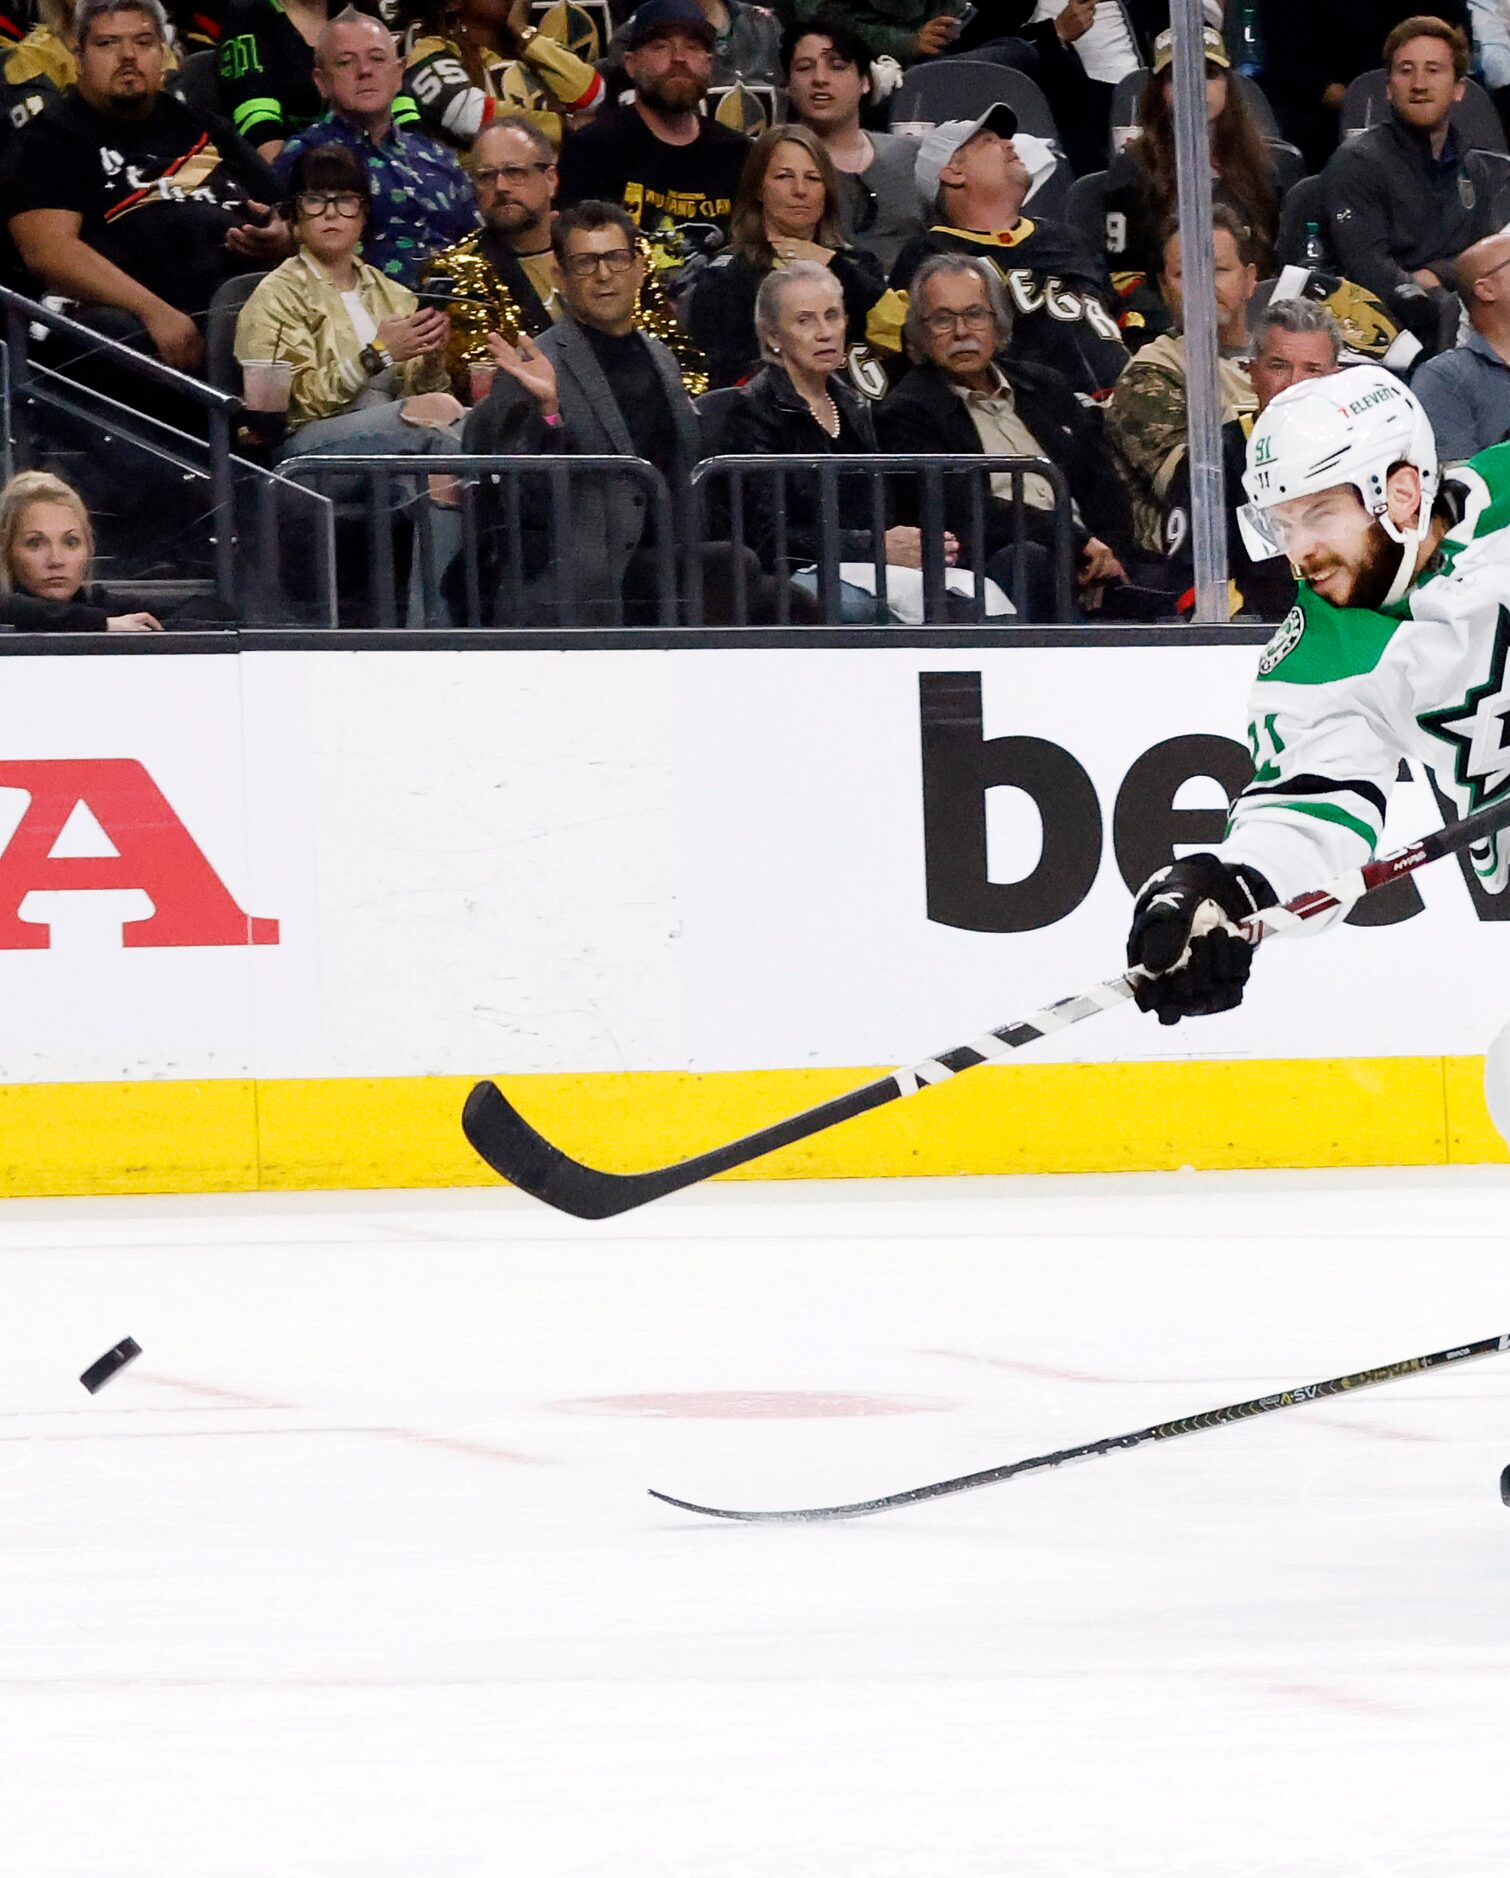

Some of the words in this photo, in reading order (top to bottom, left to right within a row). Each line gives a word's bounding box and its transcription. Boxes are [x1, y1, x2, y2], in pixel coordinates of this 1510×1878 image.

[412, 58, 470, 105] 55
[1255, 435, 1272, 462] 91
[0, 757, 280, 951] A
